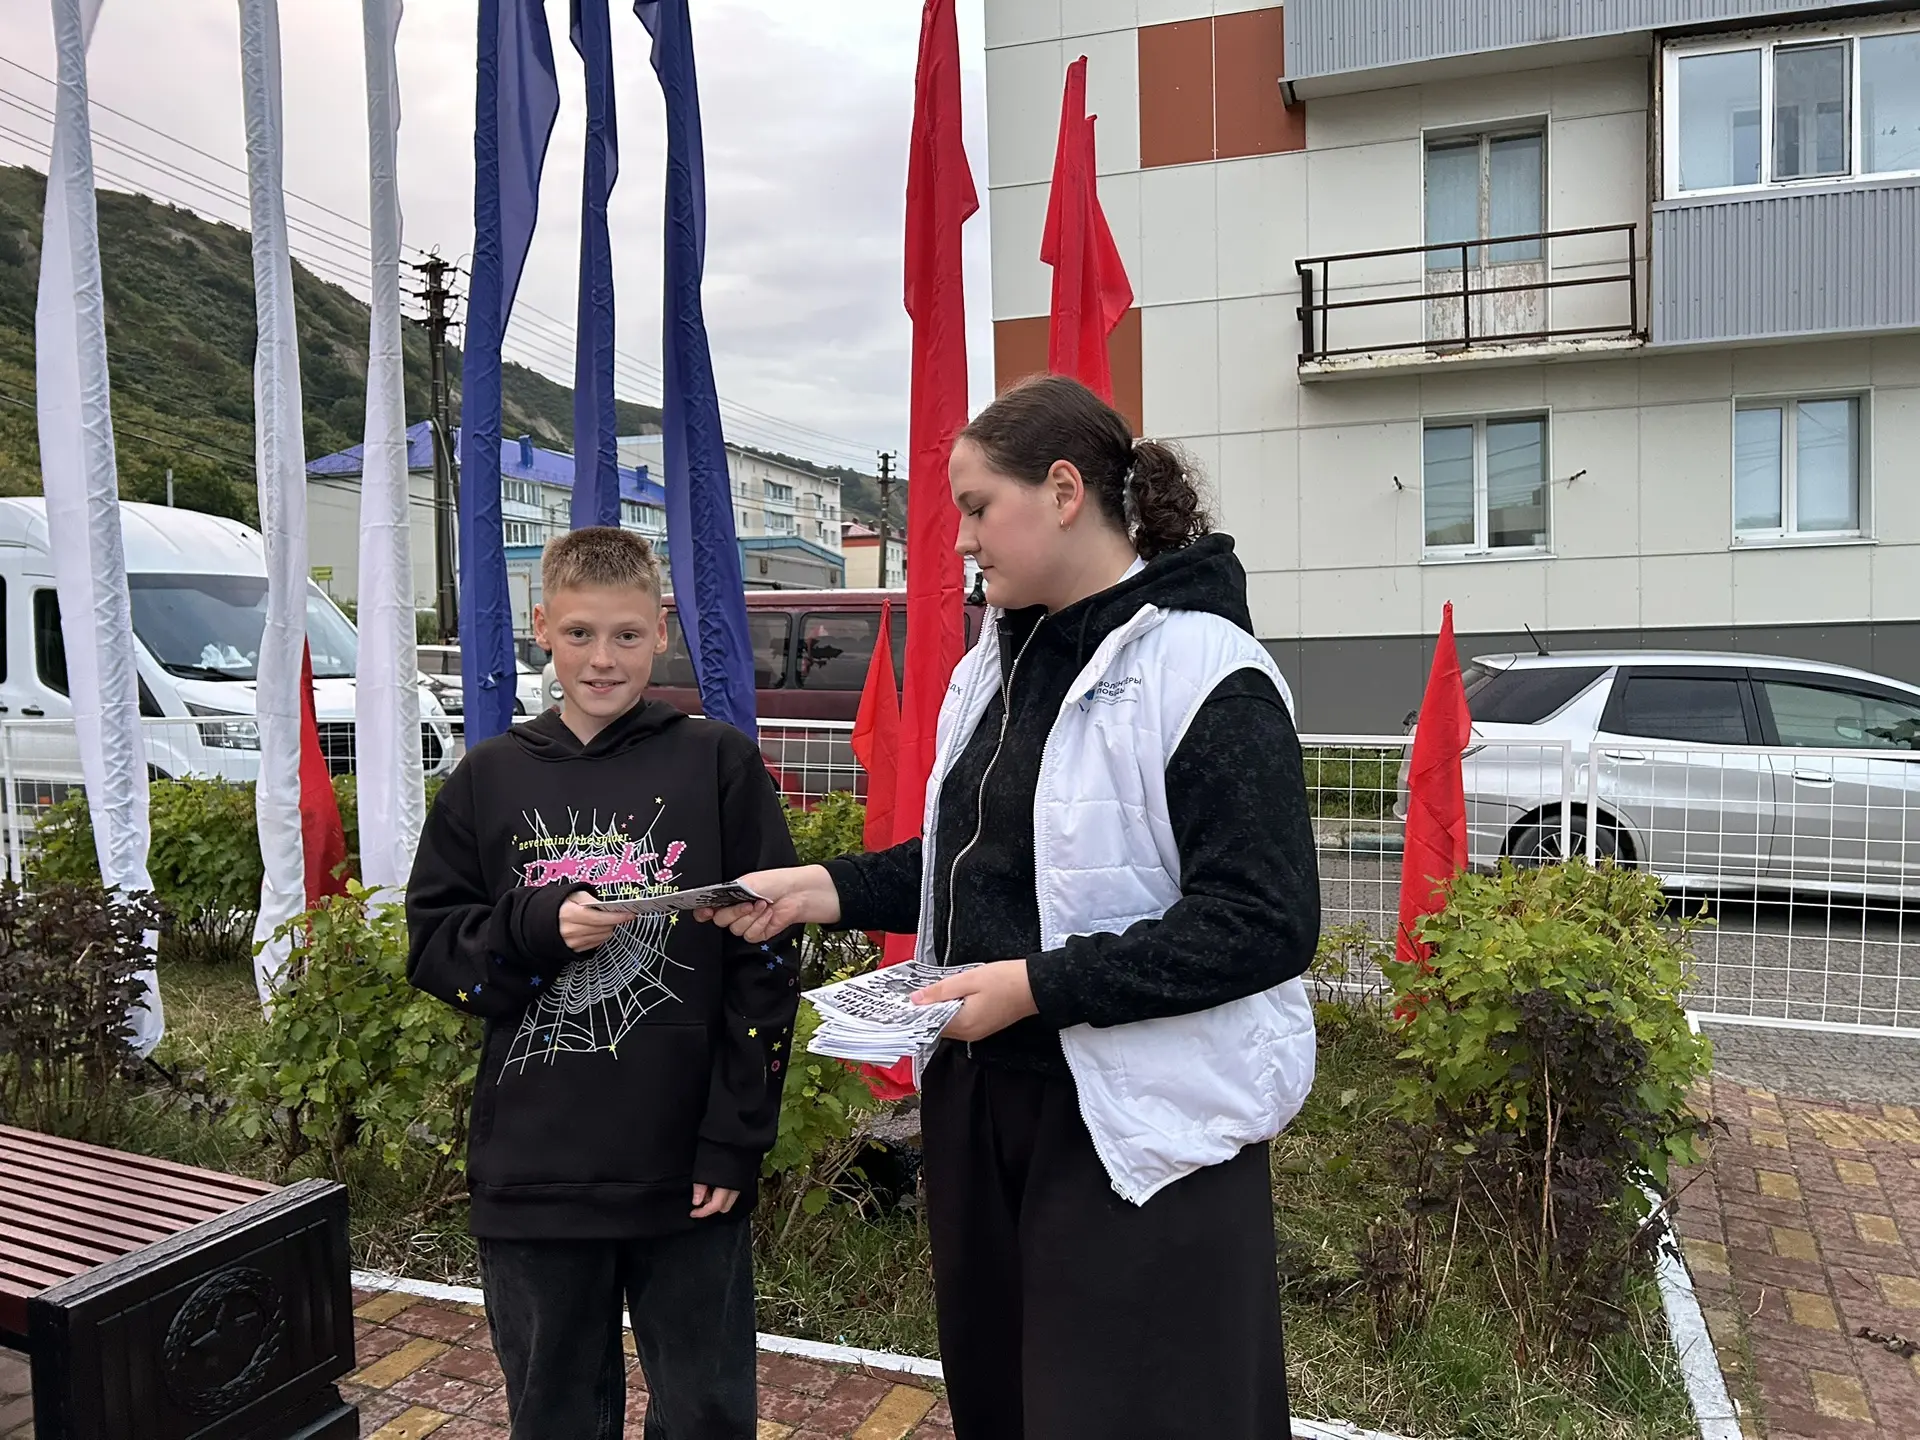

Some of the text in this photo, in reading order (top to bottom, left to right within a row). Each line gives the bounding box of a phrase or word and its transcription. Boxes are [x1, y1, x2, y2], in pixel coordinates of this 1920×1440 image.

[1098, 676, 1142, 690] ВОЛНЕРЫ
[518, 832, 632, 850] nevermind the spider.
[647, 882, 680, 894] slime
